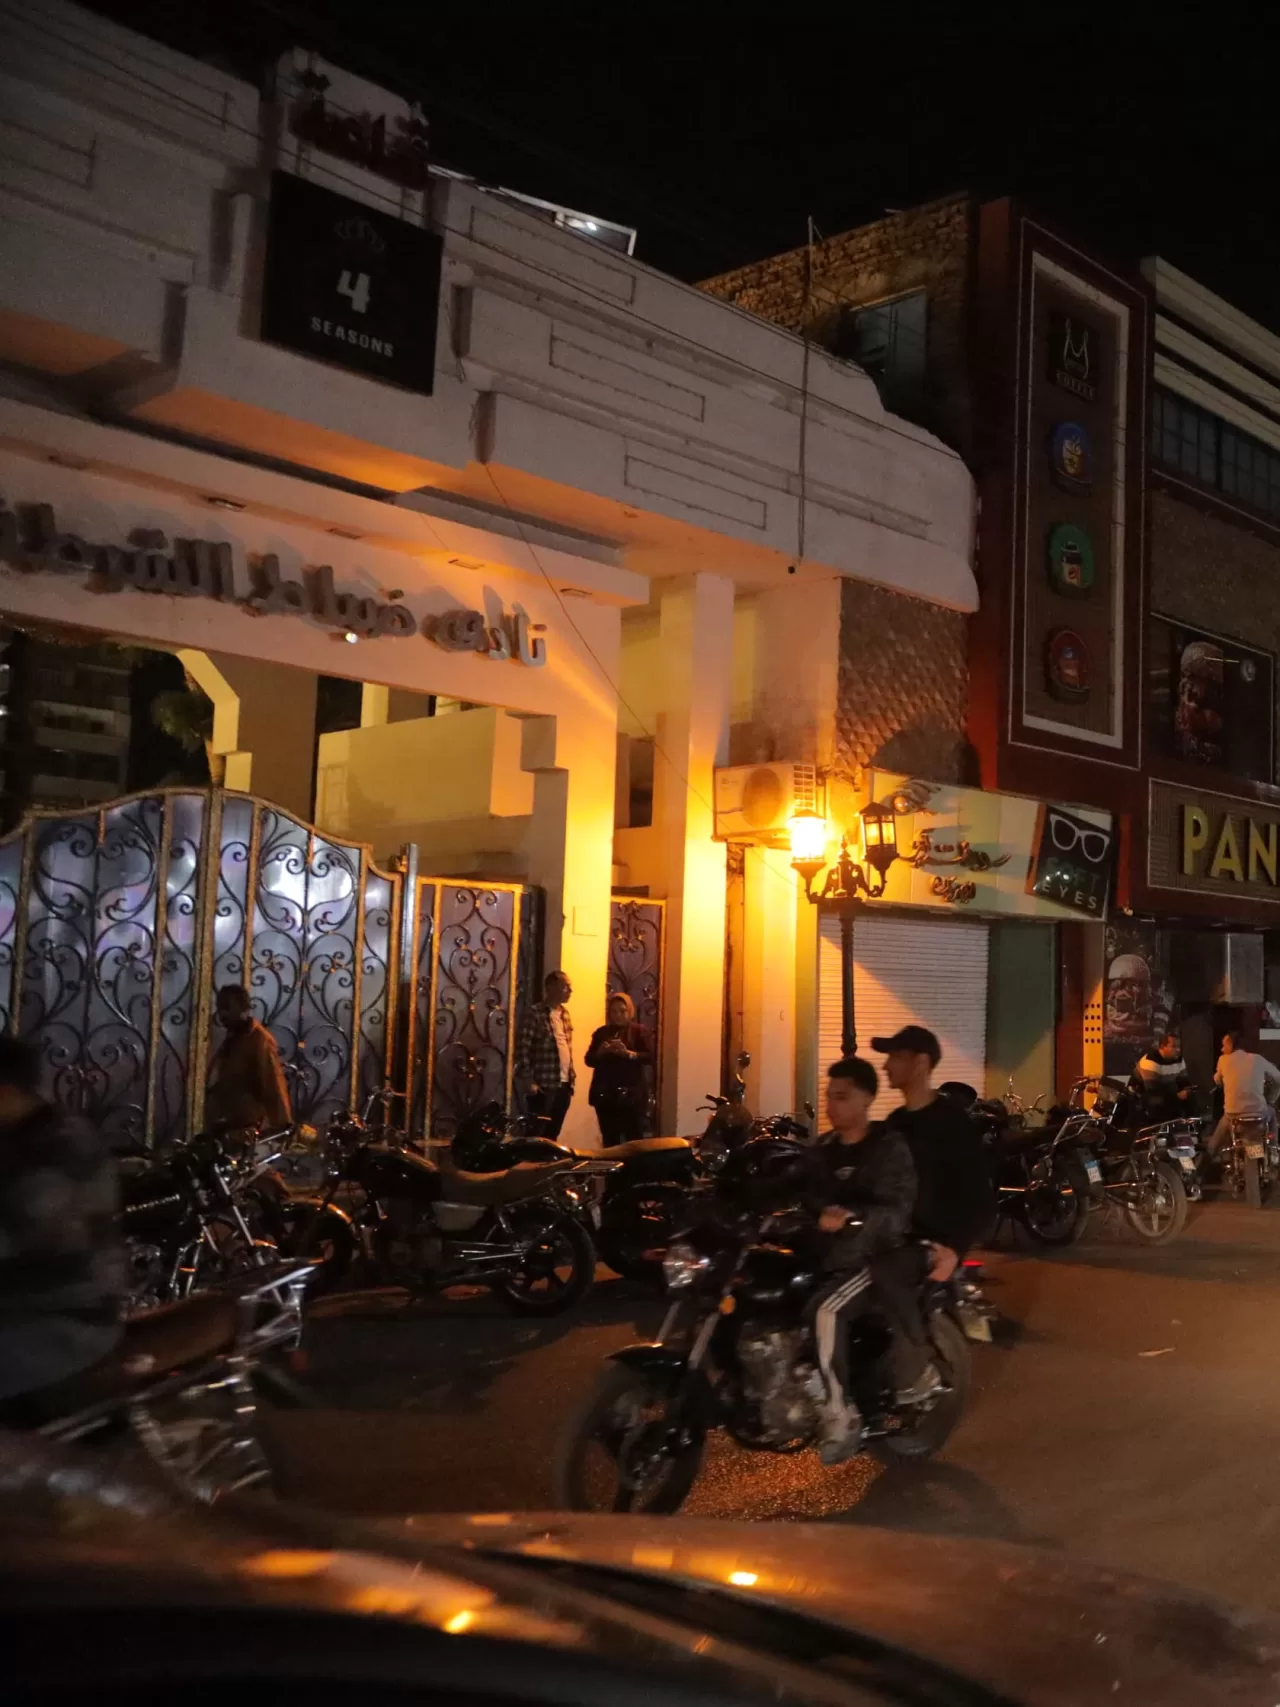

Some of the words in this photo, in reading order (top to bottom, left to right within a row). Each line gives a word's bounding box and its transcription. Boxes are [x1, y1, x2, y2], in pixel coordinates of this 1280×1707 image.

[336, 268, 372, 314] 4
[310, 315, 395, 358] SEASONS
[246, 553, 417, 640] ضباط
[1042, 878, 1098, 909] EYES
[1044, 857, 1101, 894] SOFT
